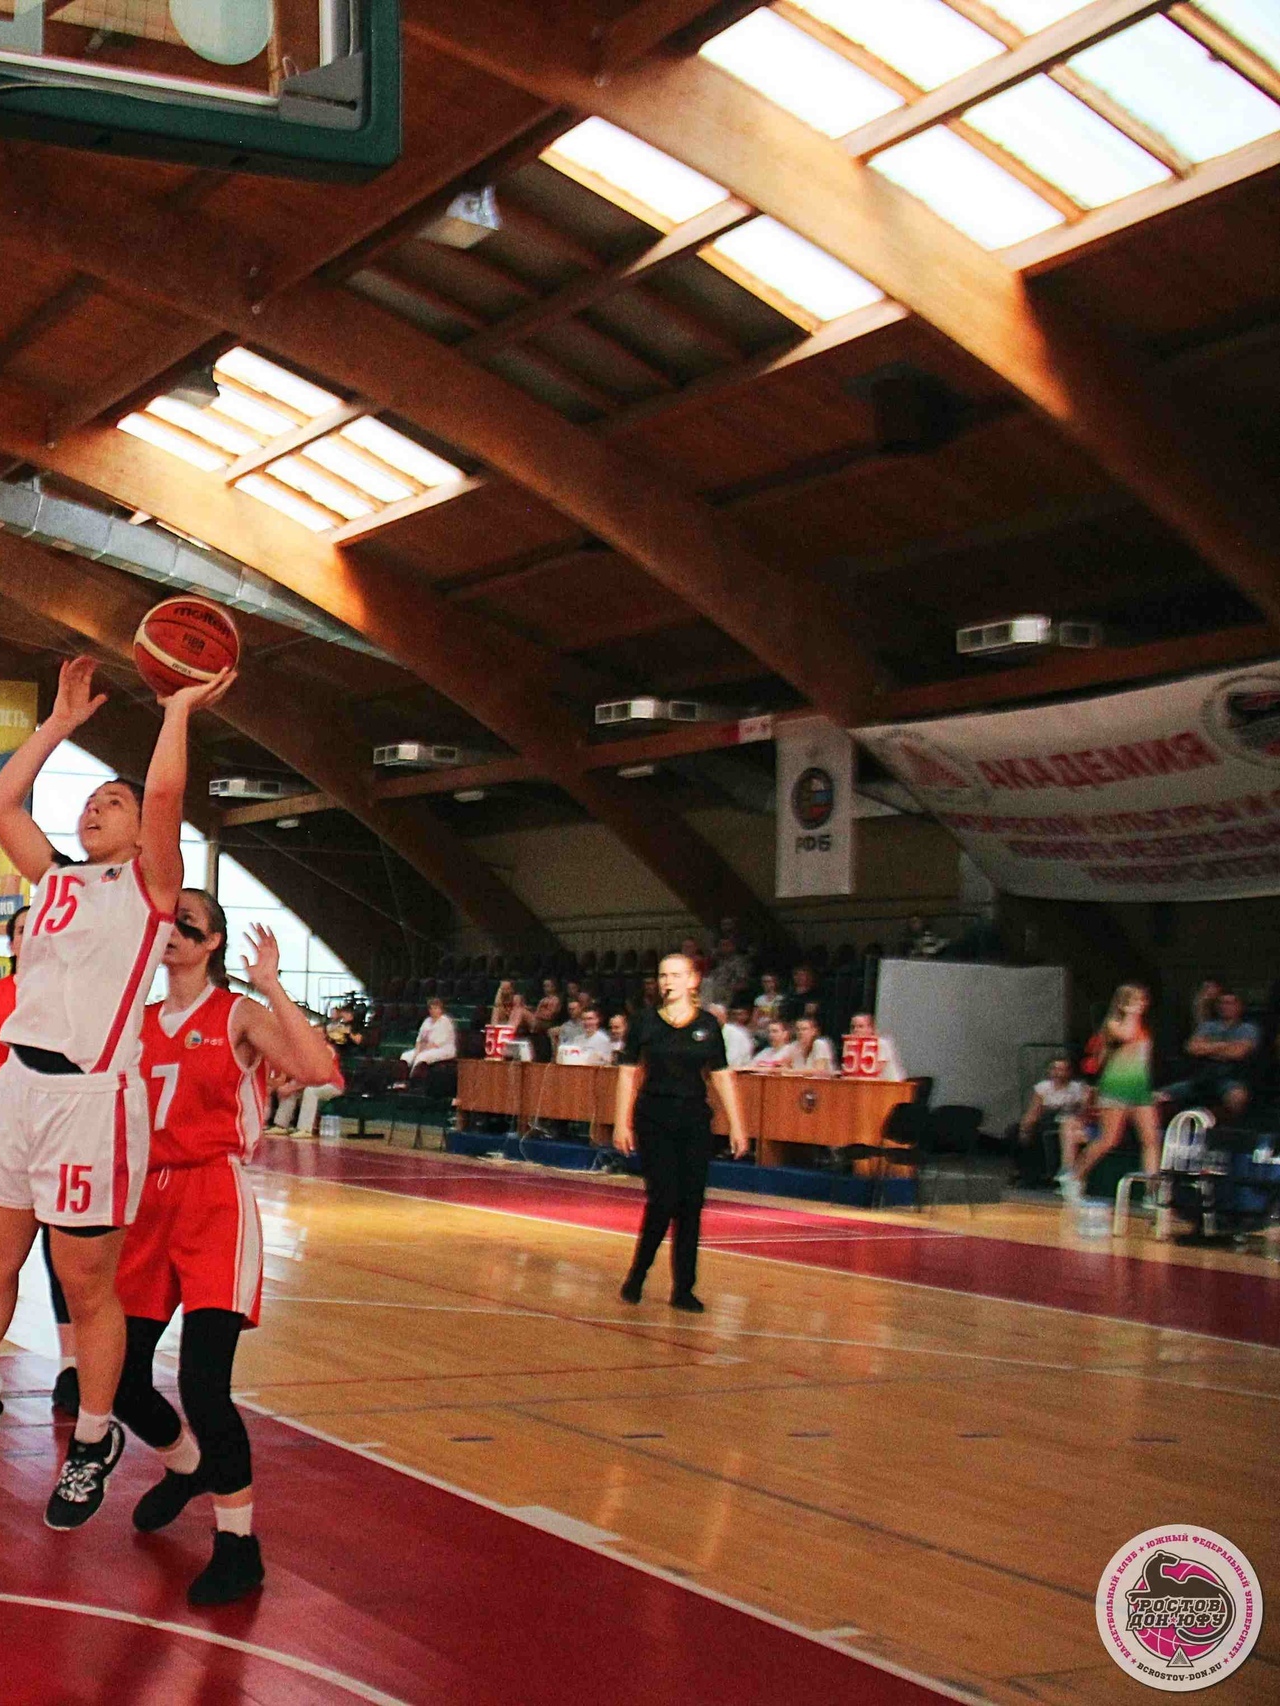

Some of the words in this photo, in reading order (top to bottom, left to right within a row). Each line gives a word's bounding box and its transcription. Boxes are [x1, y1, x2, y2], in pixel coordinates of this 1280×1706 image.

[174, 607, 231, 639] molten
[975, 730, 1221, 790] АКАДЕМИЯ
[32, 875, 86, 936] 15
[841, 1040, 877, 1073] 55
[151, 1063, 179, 1131] 7
[56, 1164, 93, 1213] 15
